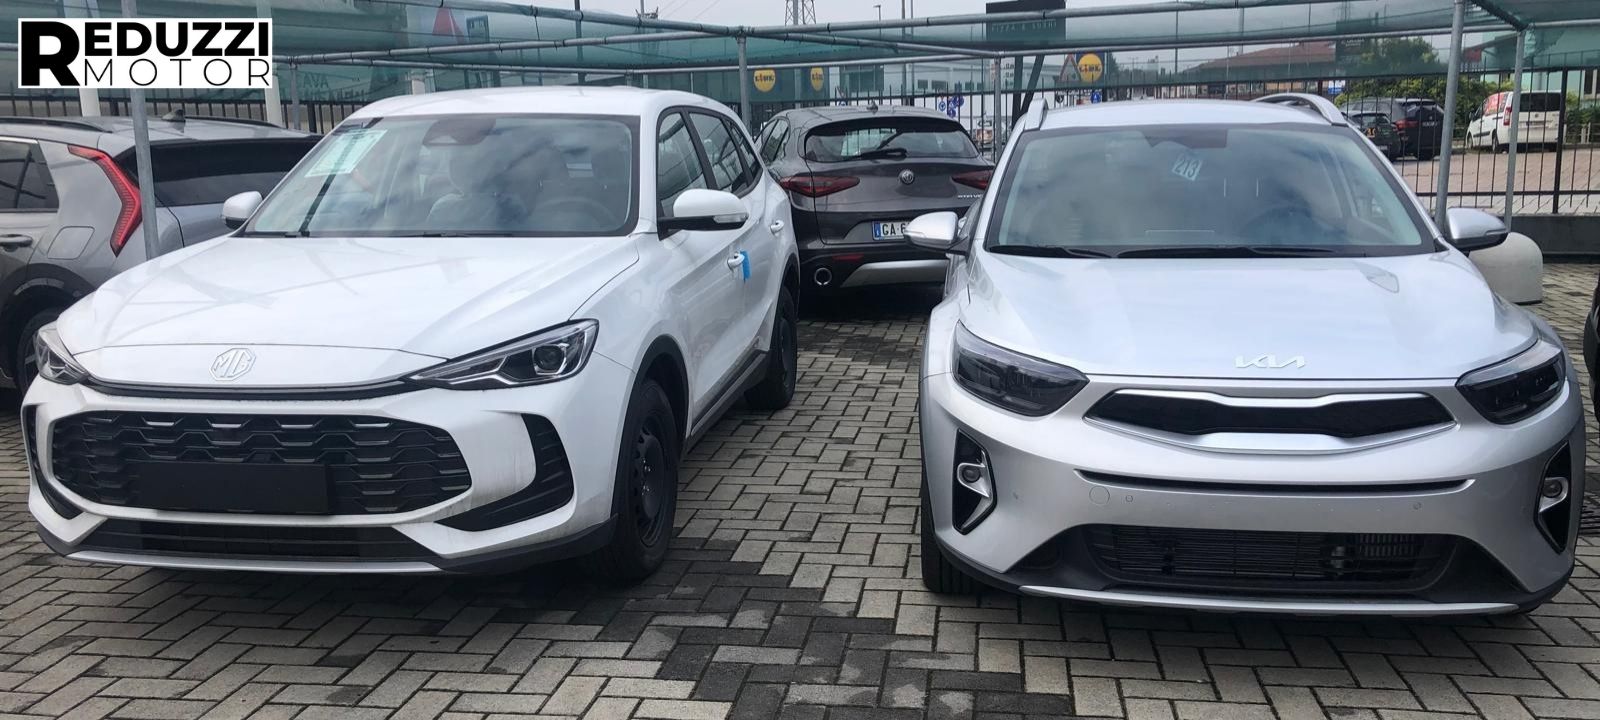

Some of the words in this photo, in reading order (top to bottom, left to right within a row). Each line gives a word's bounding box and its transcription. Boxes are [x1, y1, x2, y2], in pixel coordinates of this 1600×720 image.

[1173, 158, 1200, 178] 213
[212, 349, 253, 379] MG
[1235, 354, 1305, 369] KIA
